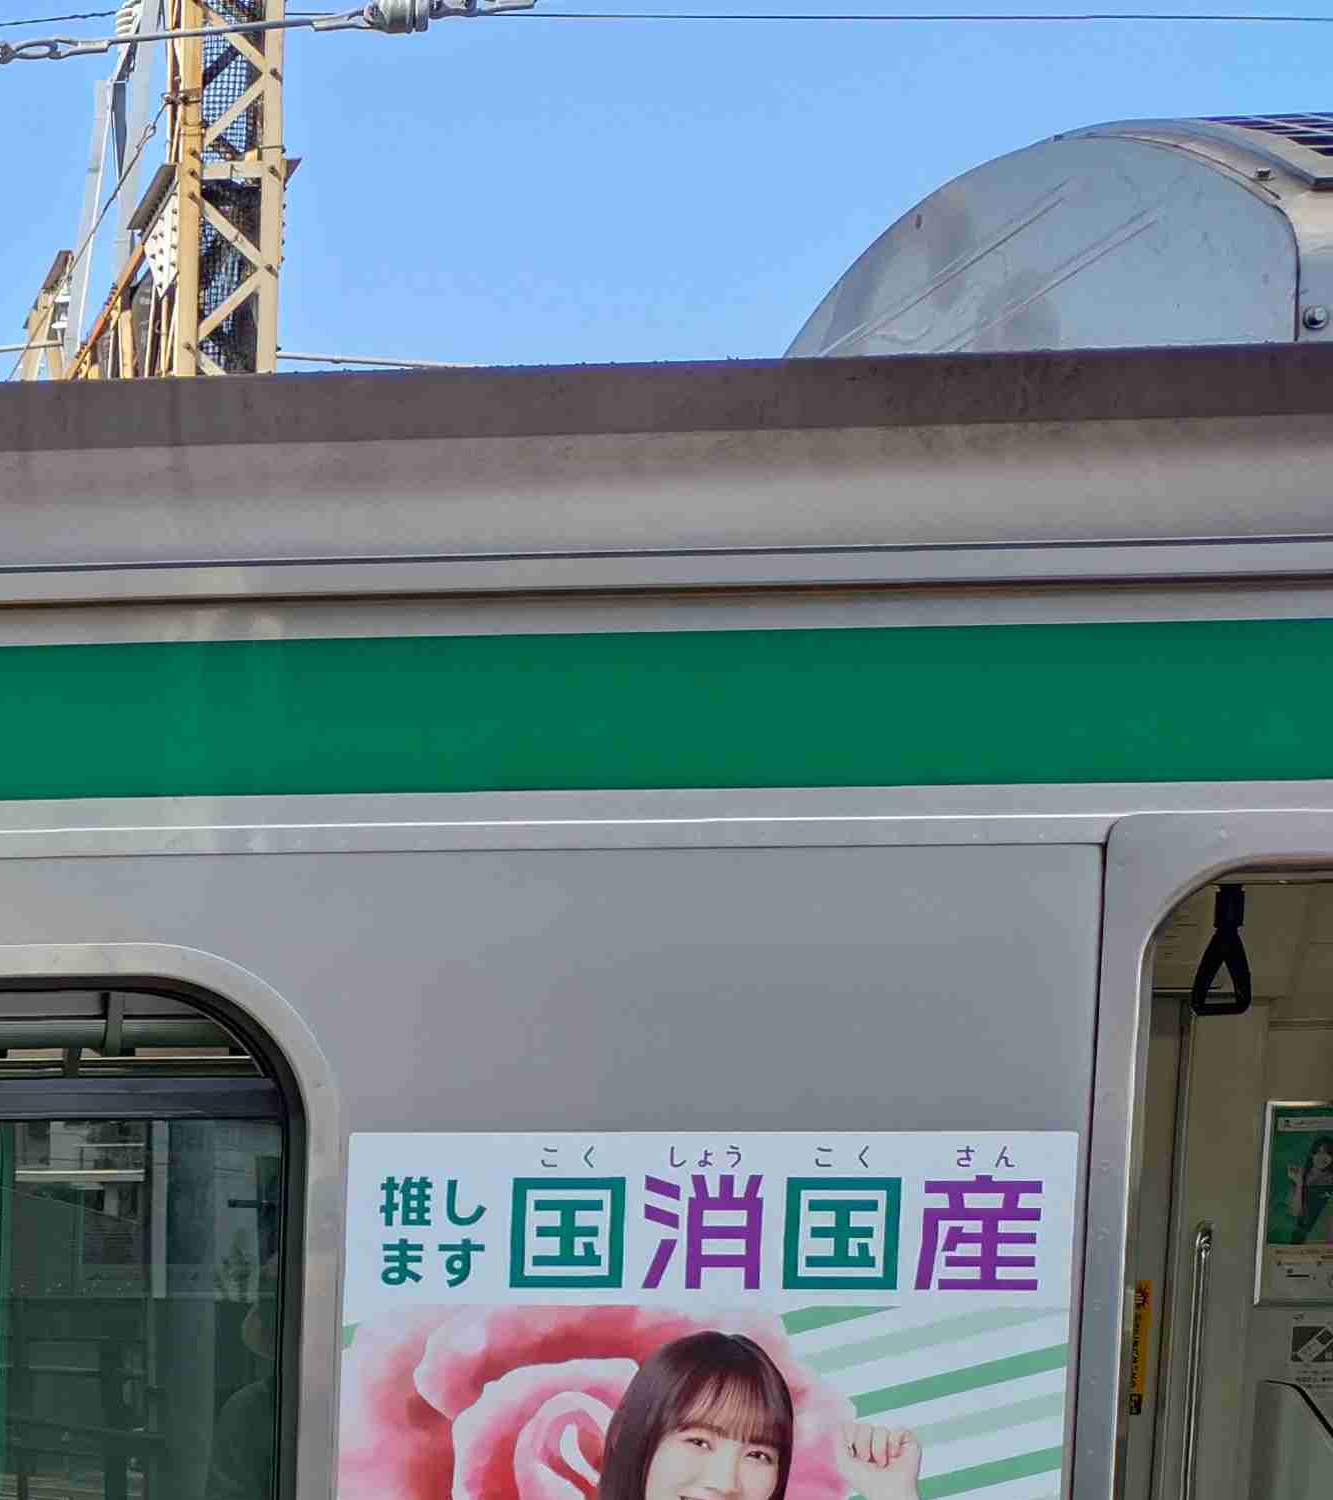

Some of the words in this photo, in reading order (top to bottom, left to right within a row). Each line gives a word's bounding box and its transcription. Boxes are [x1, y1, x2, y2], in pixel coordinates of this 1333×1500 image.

[540, 1146, 595, 1168] こく
[670, 1145, 742, 1168] しょう
[815, 1146, 869, 1168] こく
[956, 1146, 1015, 1168] さん
[379, 1176, 488, 1227] 推し
[508, 1174, 1043, 1290] 国消国産
[380, 1238, 486, 1288] ます
